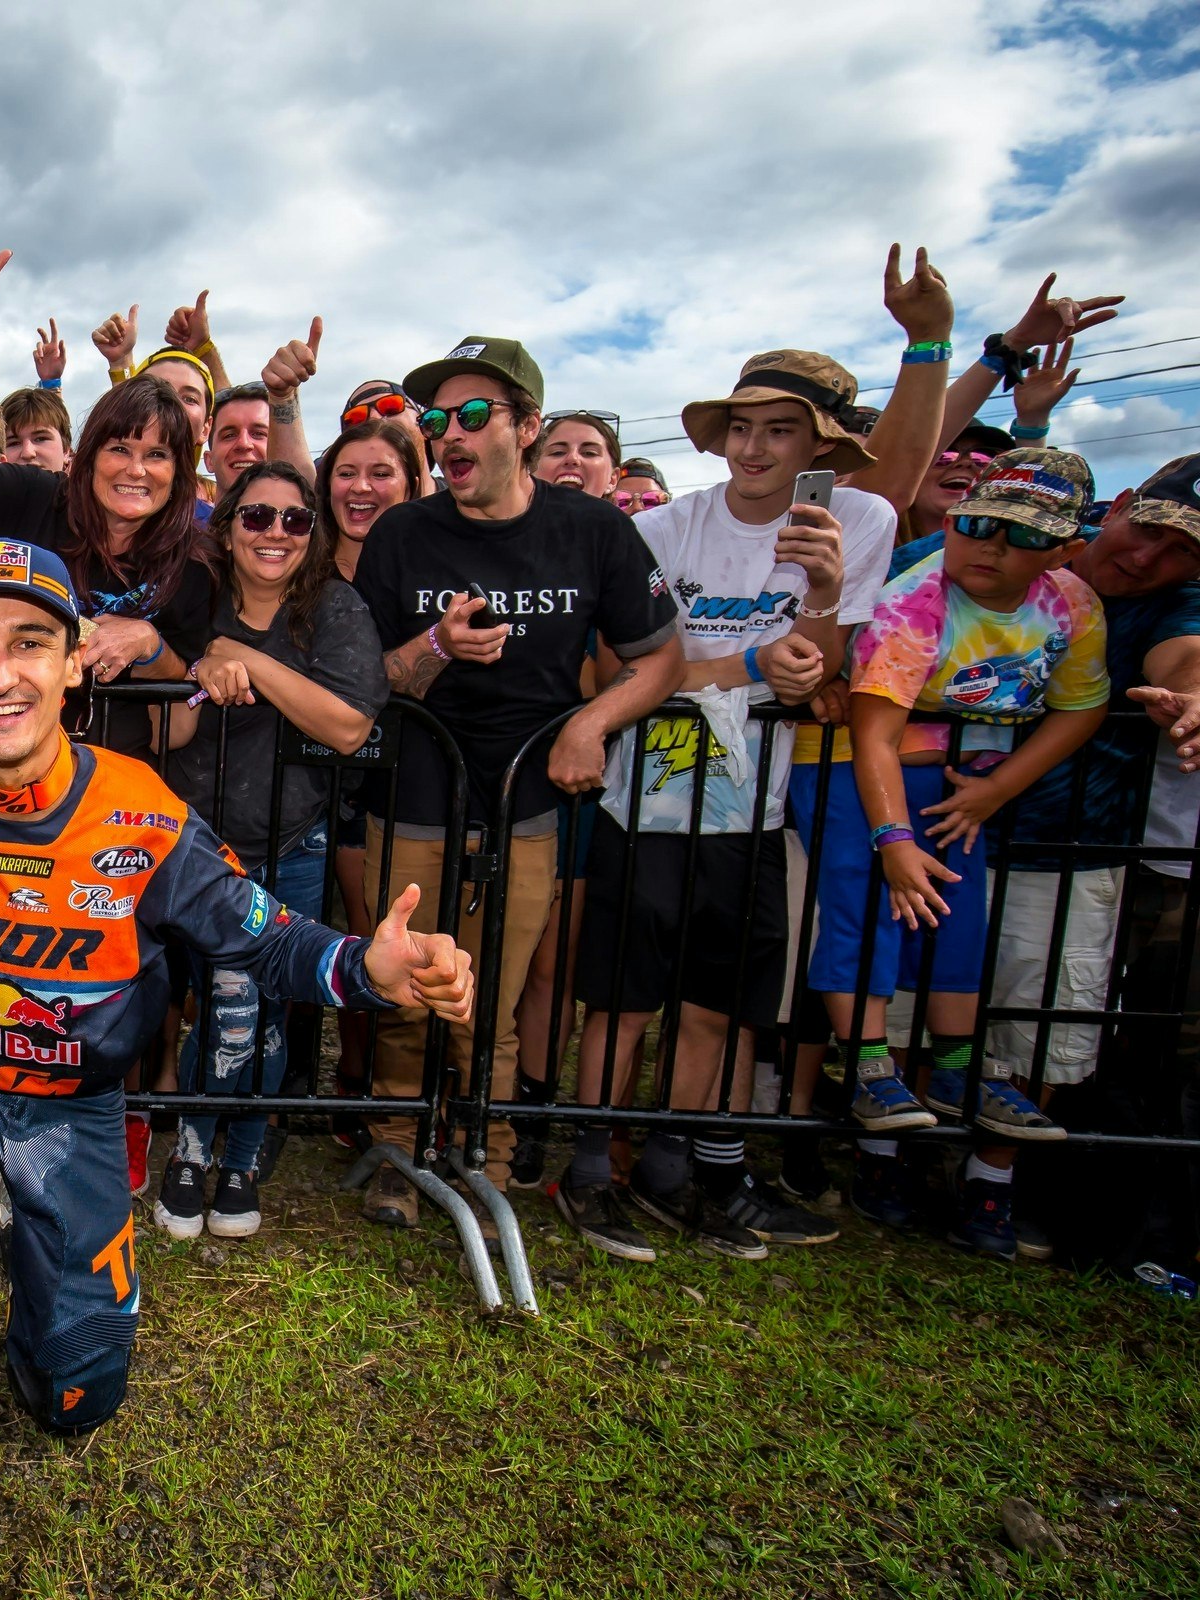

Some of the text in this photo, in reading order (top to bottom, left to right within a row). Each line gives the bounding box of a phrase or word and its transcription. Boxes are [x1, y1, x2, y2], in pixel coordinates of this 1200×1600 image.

[988, 479, 1069, 499] MOTOCROSS
[0, 553, 28, 567] Bull
[415, 588, 579, 615] FOREST
[688, 591, 793, 621] WMX
[102, 810, 179, 829] AMA PRO
[156, 823, 179, 834] RACING
[96, 850, 149, 868] Airoh
[68, 880, 134, 911] PARADISE
[6, 901, 50, 914] RENTHAL
[4, 1030, 81, 1067] Bull
